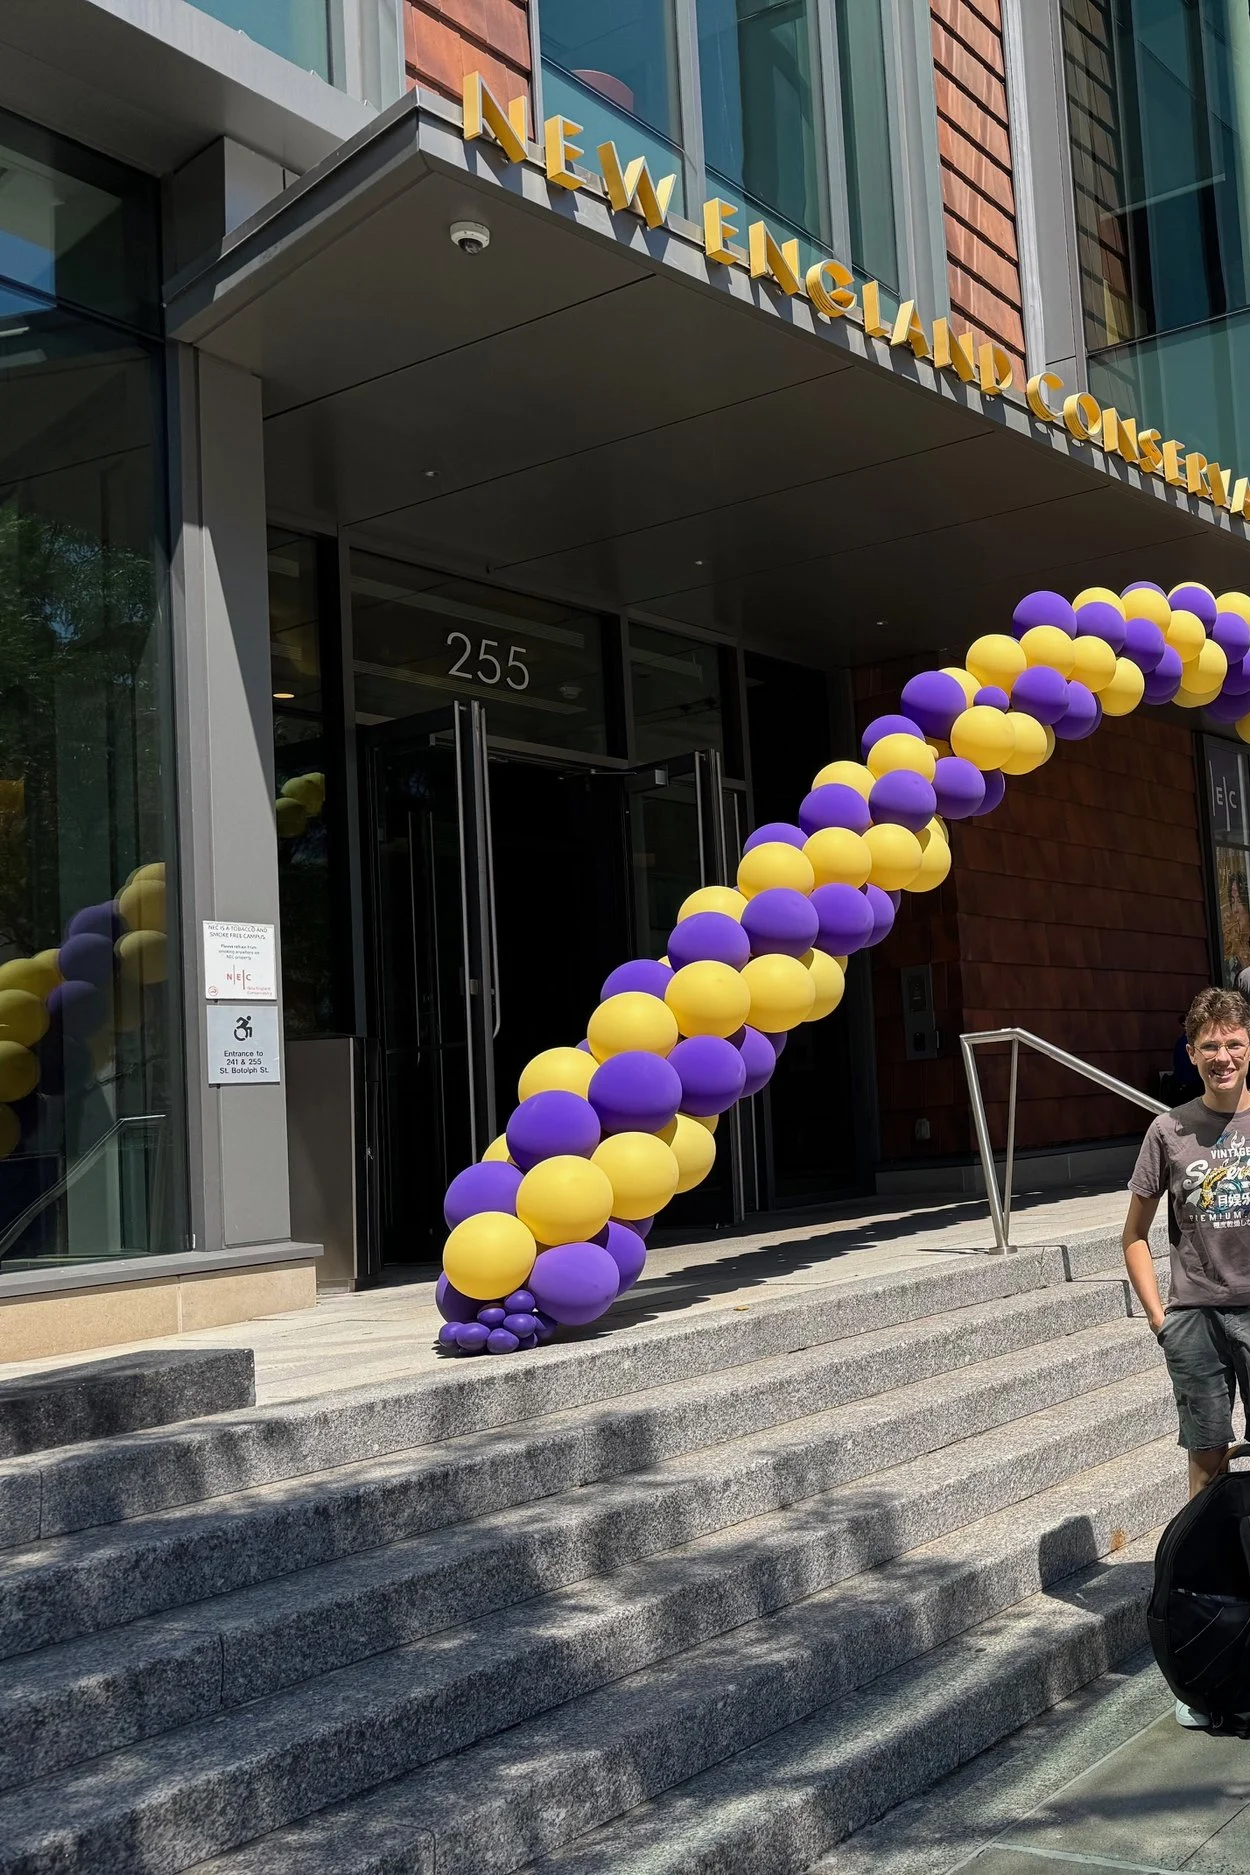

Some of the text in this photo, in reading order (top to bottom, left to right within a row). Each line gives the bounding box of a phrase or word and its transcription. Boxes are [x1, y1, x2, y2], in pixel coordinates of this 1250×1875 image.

[463, 71, 677, 229] NEW
[703, 197, 1013, 396] ENGLAND
[447, 631, 529, 690] 255
